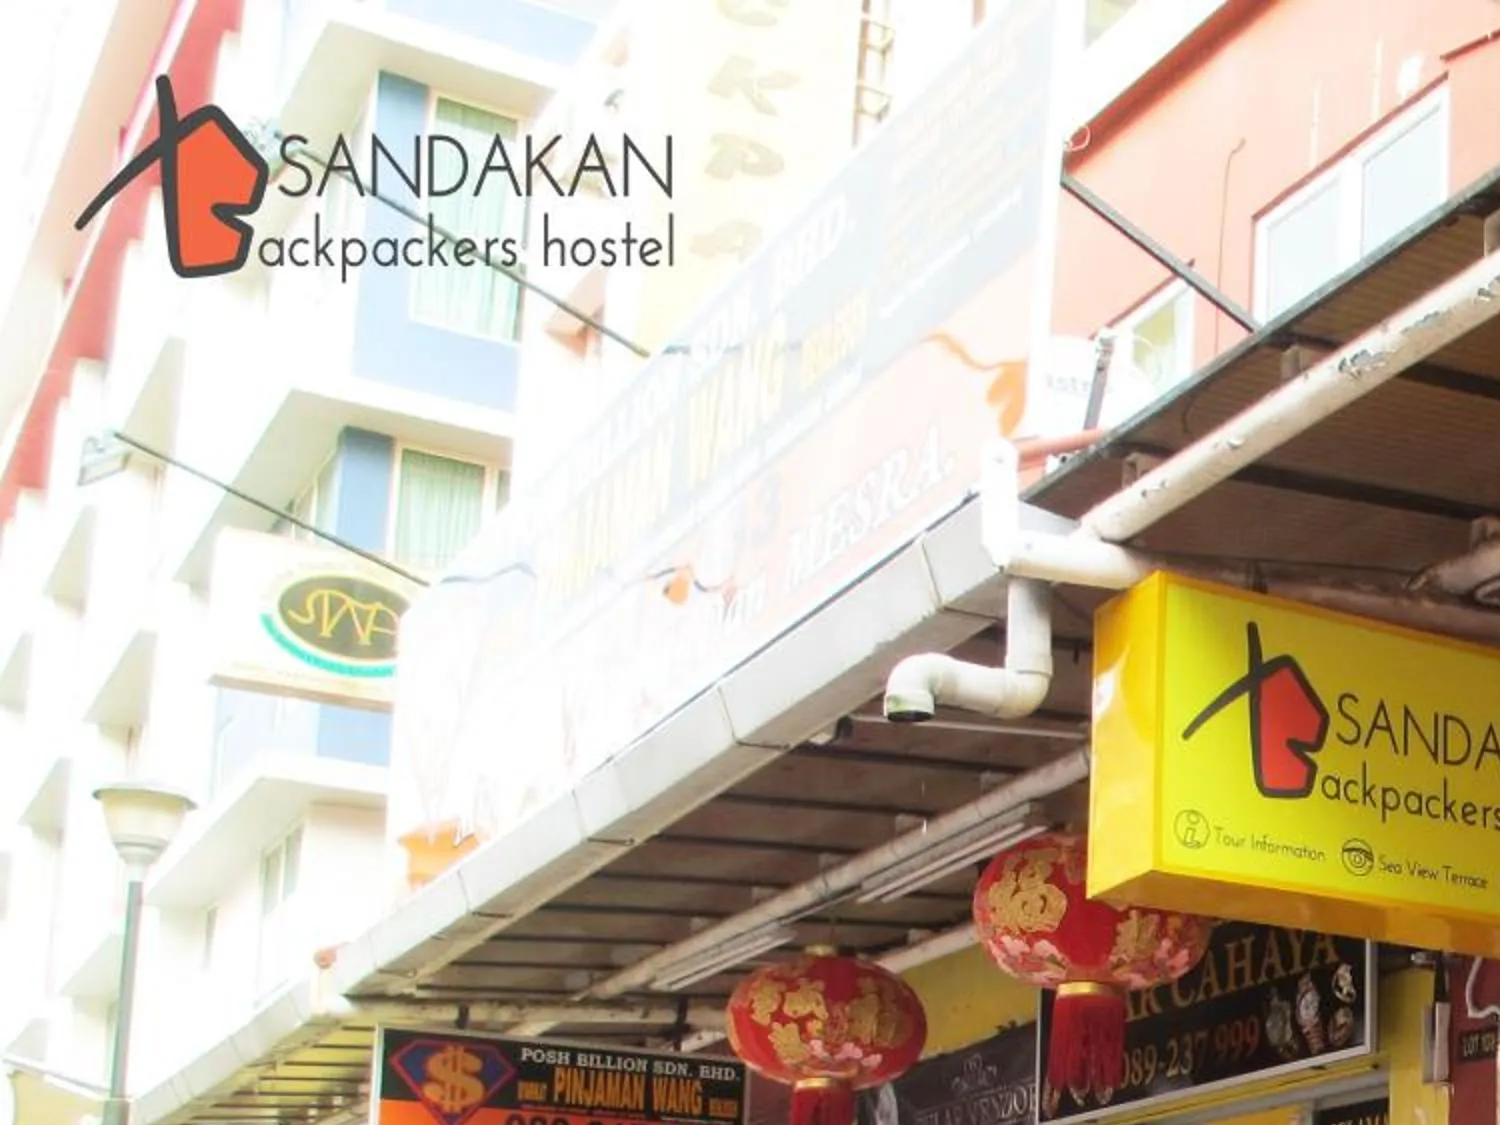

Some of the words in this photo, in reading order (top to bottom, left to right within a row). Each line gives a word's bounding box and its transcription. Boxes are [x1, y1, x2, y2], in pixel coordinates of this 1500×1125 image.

[1214, 827, 1246, 849] Tour
[1250, 833, 1326, 863] Information
[1406, 861, 1440, 882] View
[1443, 867, 1489, 891] Terrace
[521, 1047, 571, 1065] POSH
[577, 1053, 648, 1073] BILLION
[652, 1061, 693, 1078] SDN.
[553, 1067, 646, 1111] PINJAMAN
[652, 1076, 703, 1115] WANG
